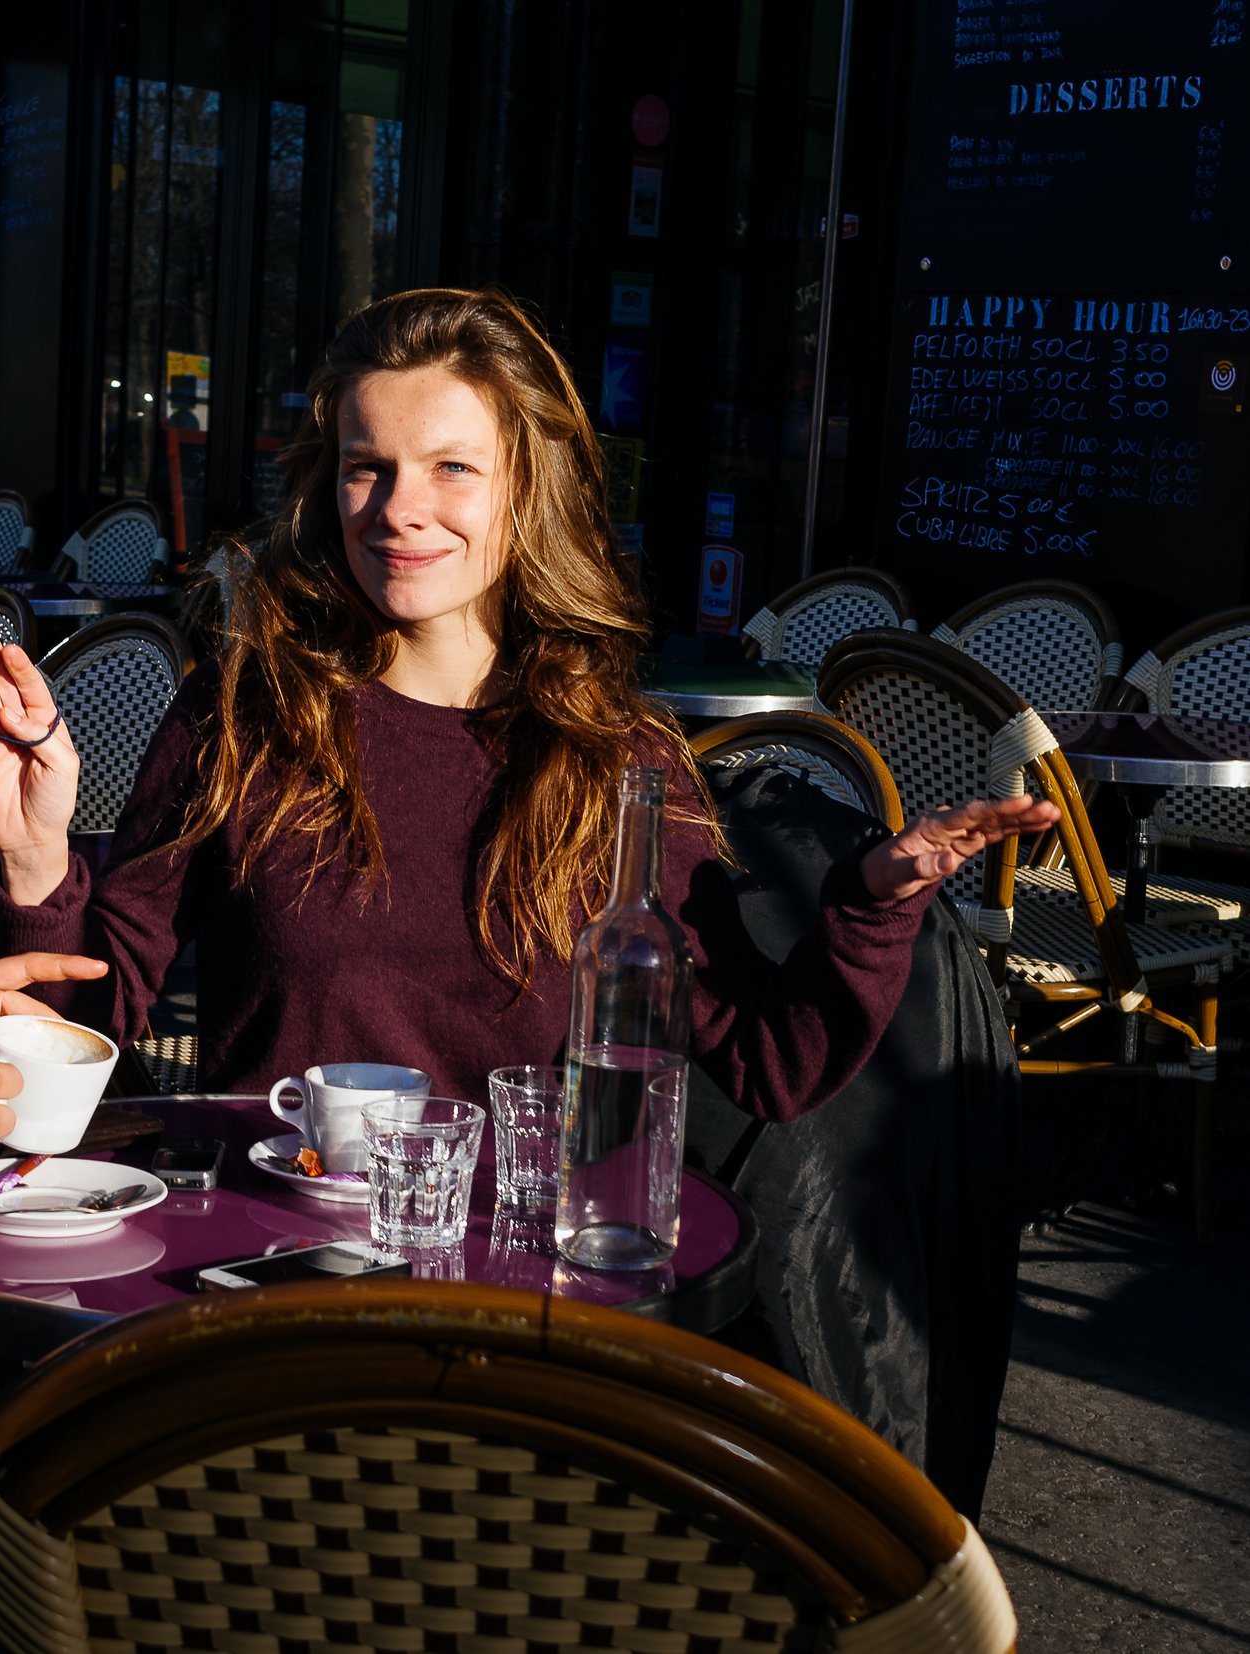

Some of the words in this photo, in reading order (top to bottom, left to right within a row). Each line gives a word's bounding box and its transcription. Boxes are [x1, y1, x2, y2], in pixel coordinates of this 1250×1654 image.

[953, 50, 1011, 69] SUGGESTION
[1008, 75, 1203, 115] DESSERTS
[928, 296, 1053, 330] HAPPY
[1072, 300, 1171, 334] HOUR
[913, 332, 1022, 361] PELFORTH
[1110, 338, 1169, 364] 3.50
[910, 365, 1030, 393] EDELWEISS
[1109, 366, 1167, 390] 5.00
[1108, 395, 1169, 420] 5.00
[906, 421, 982, 451] PLANCHE
[989, 426, 1050, 456] MIXTE
[901, 475, 990, 515] SPRITZ
[896, 511, 956, 543] CUBA
[958, 522, 1014, 552] LIBRE
